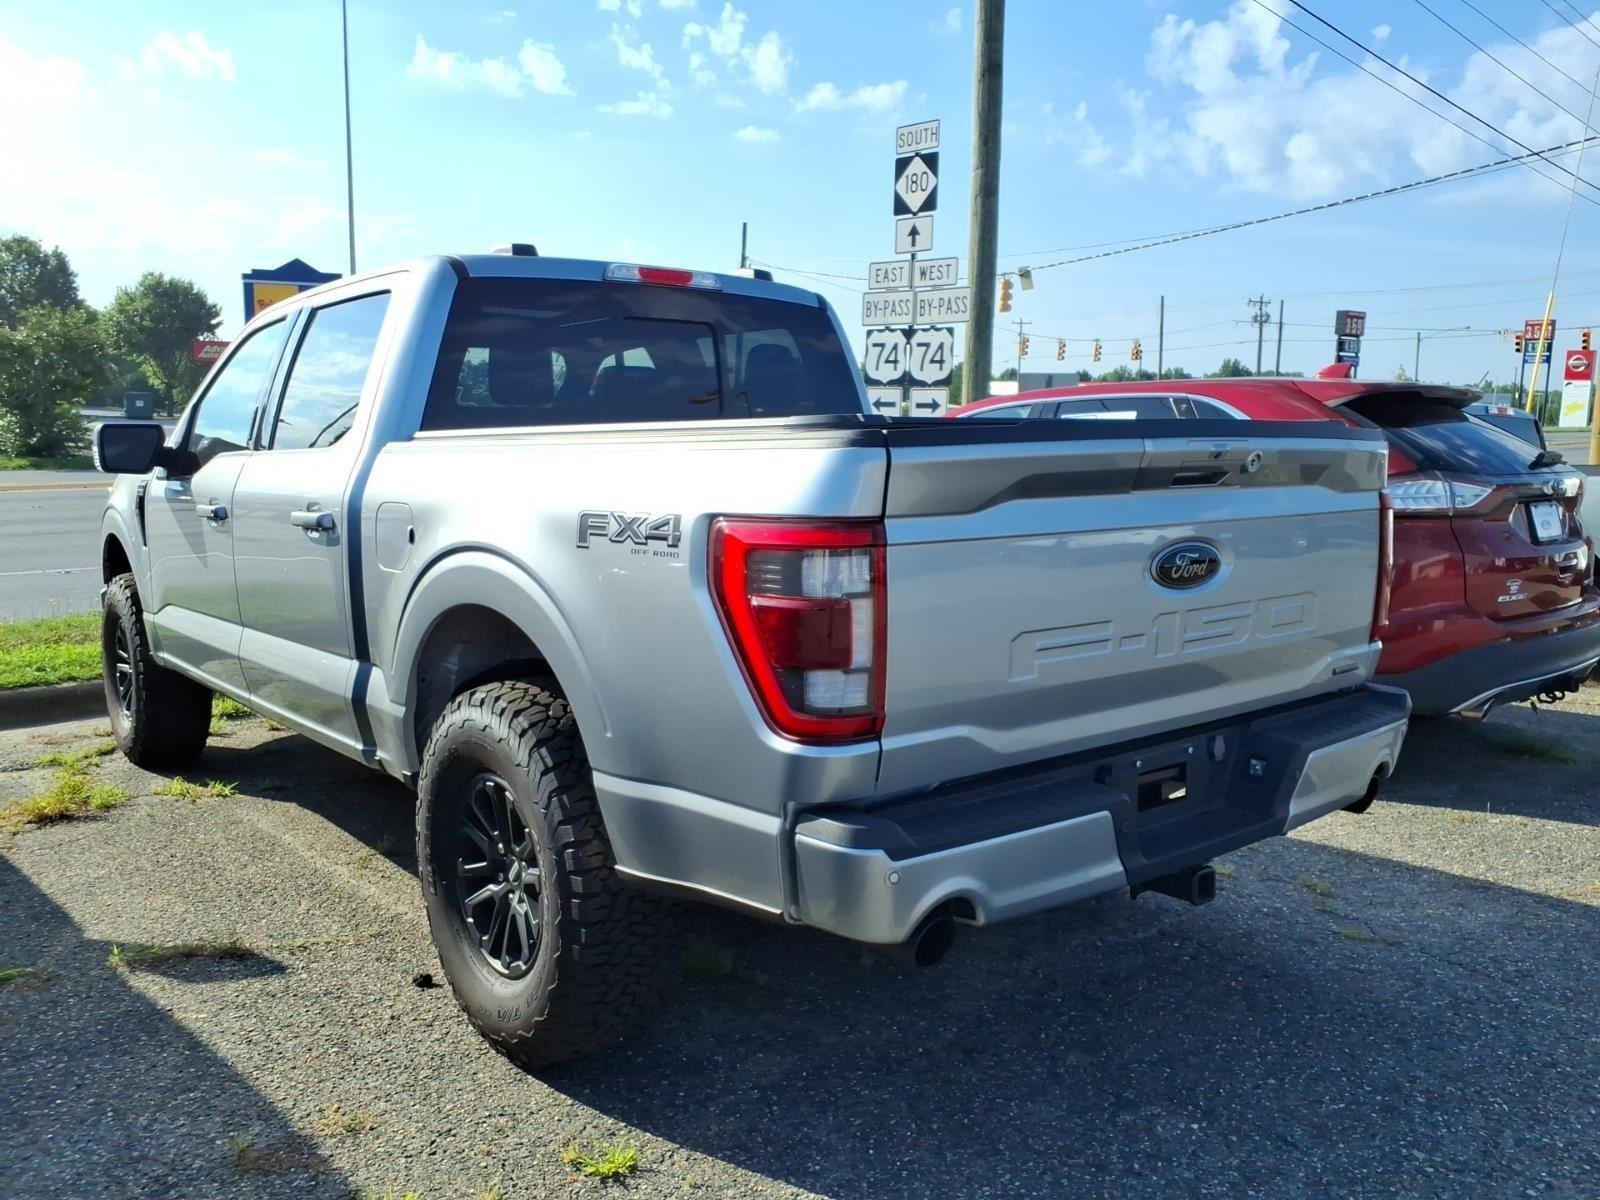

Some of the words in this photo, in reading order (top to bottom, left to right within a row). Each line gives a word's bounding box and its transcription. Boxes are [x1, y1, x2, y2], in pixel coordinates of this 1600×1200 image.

[898, 126, 938, 149] SOUTH
[904, 171, 929, 195] 180
[875, 266, 905, 283] EAST
[918, 263, 953, 281] WEST
[865, 298, 911, 318] BY-PASS
[918, 295, 968, 317] BY-PASS
[871, 342, 900, 372] 74
[916, 341, 946, 372] 74
[576, 509, 682, 549] FX4
[630, 548, 650, 556] OFF
[653, 550, 680, 559] ROAD
[1168, 552, 1210, 580] Ford
[1008, 590, 1318, 683] F-150
